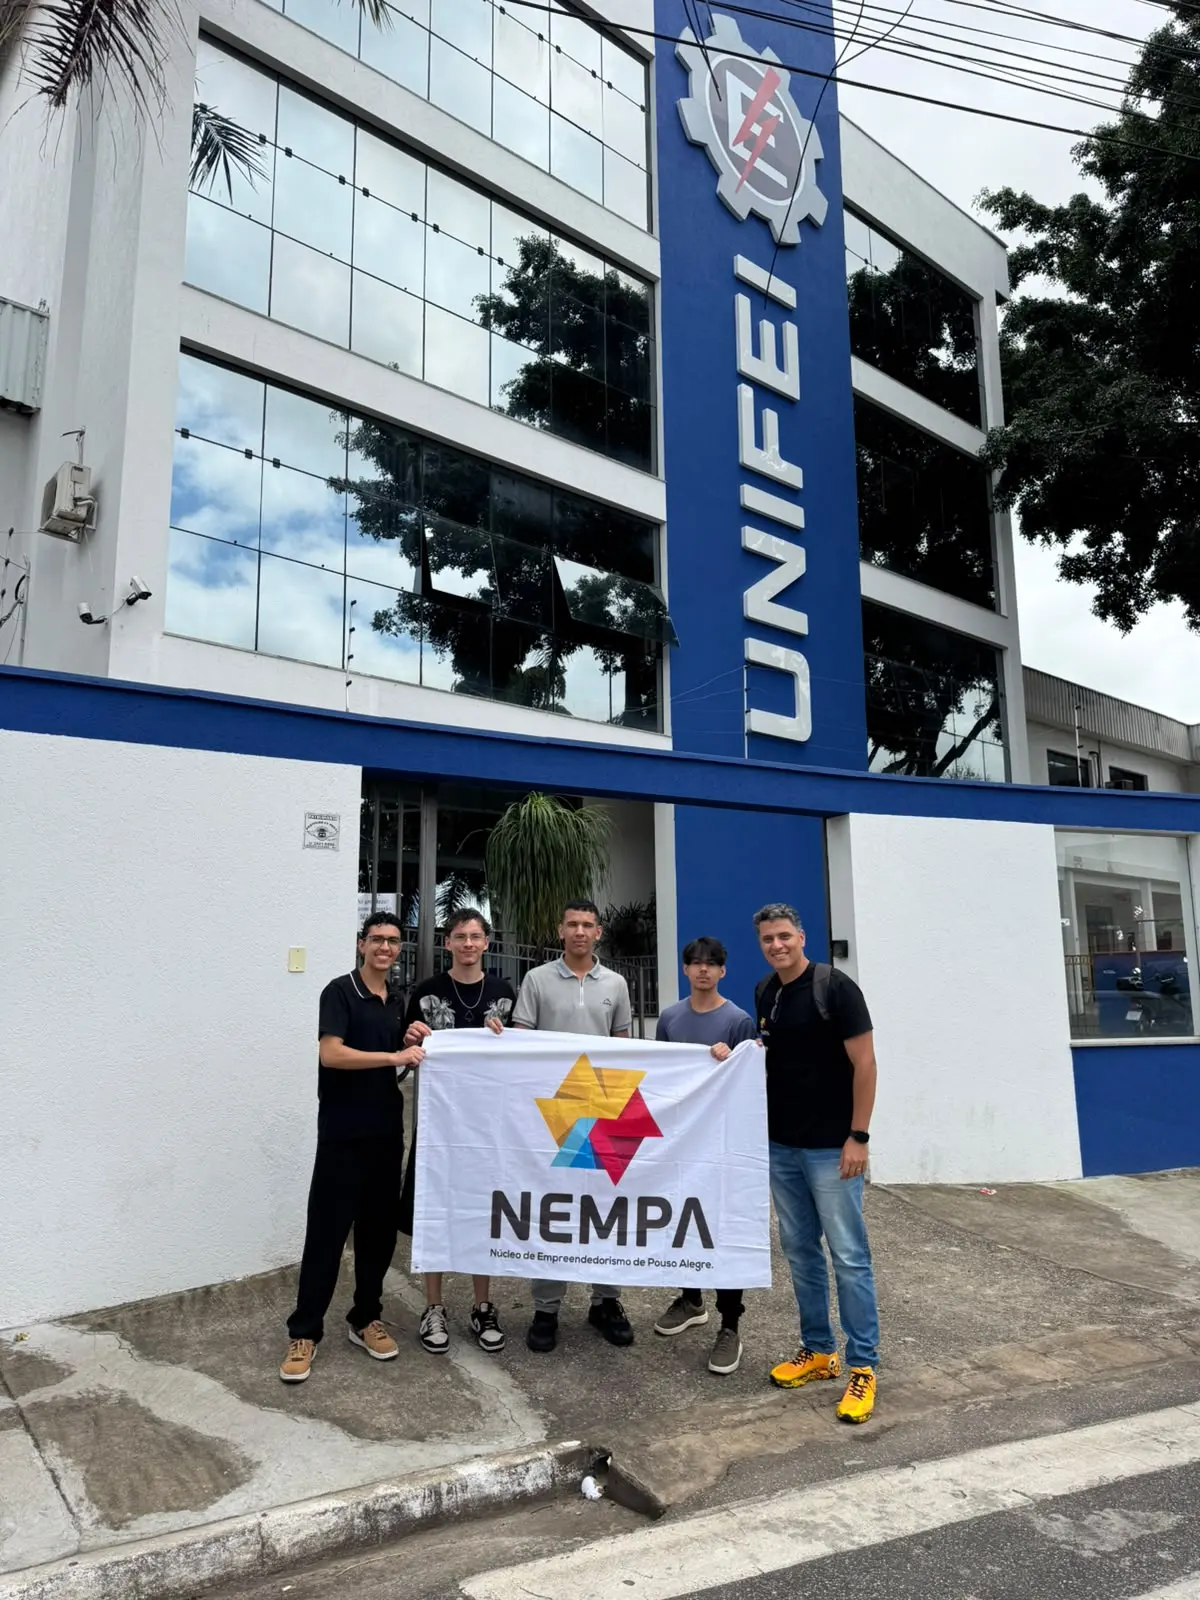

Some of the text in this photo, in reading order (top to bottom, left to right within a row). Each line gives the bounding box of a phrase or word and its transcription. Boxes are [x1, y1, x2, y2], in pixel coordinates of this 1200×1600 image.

[733, 253, 812, 743] UNIFEI
[490, 1190, 714, 1249] NEMPA
[490, 1248, 714, 1272] Núcleo de Empreendedorismo de Pouso Alegre.
